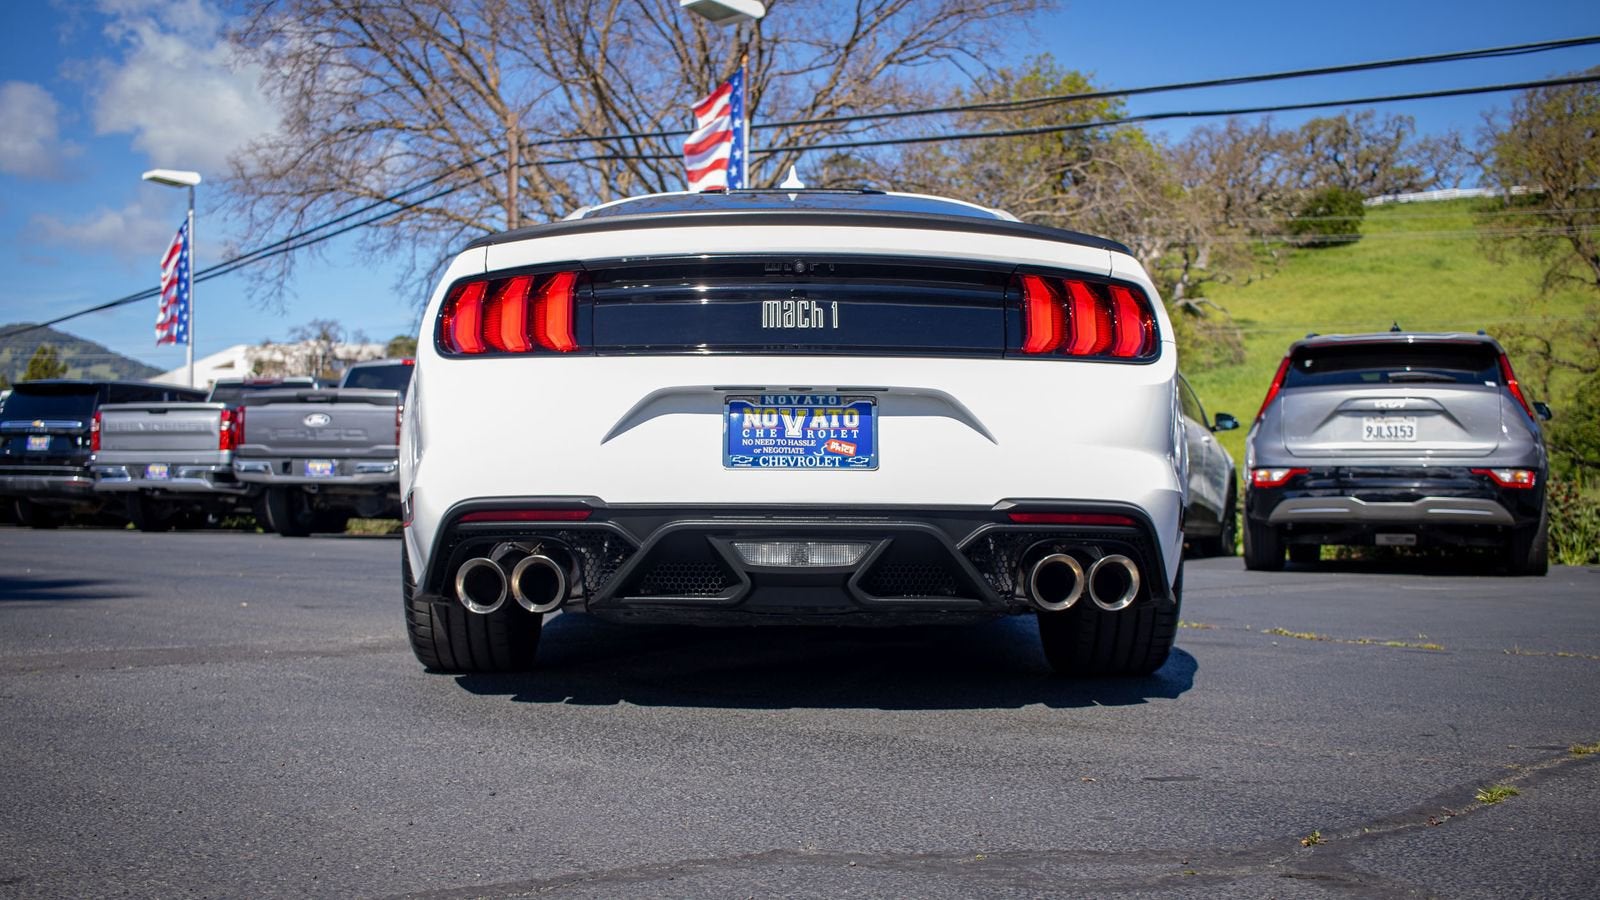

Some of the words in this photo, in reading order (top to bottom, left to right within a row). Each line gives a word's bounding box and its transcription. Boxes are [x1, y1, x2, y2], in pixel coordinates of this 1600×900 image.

[831, 300, 838, 329] 1
[764, 395, 837, 405] NOVATO
[742, 407, 860, 438] NOVATO
[1366, 425, 1414, 439] 9JLS153
[788, 439, 817, 447] HASSLE
[759, 456, 842, 467] CHEVROLET
